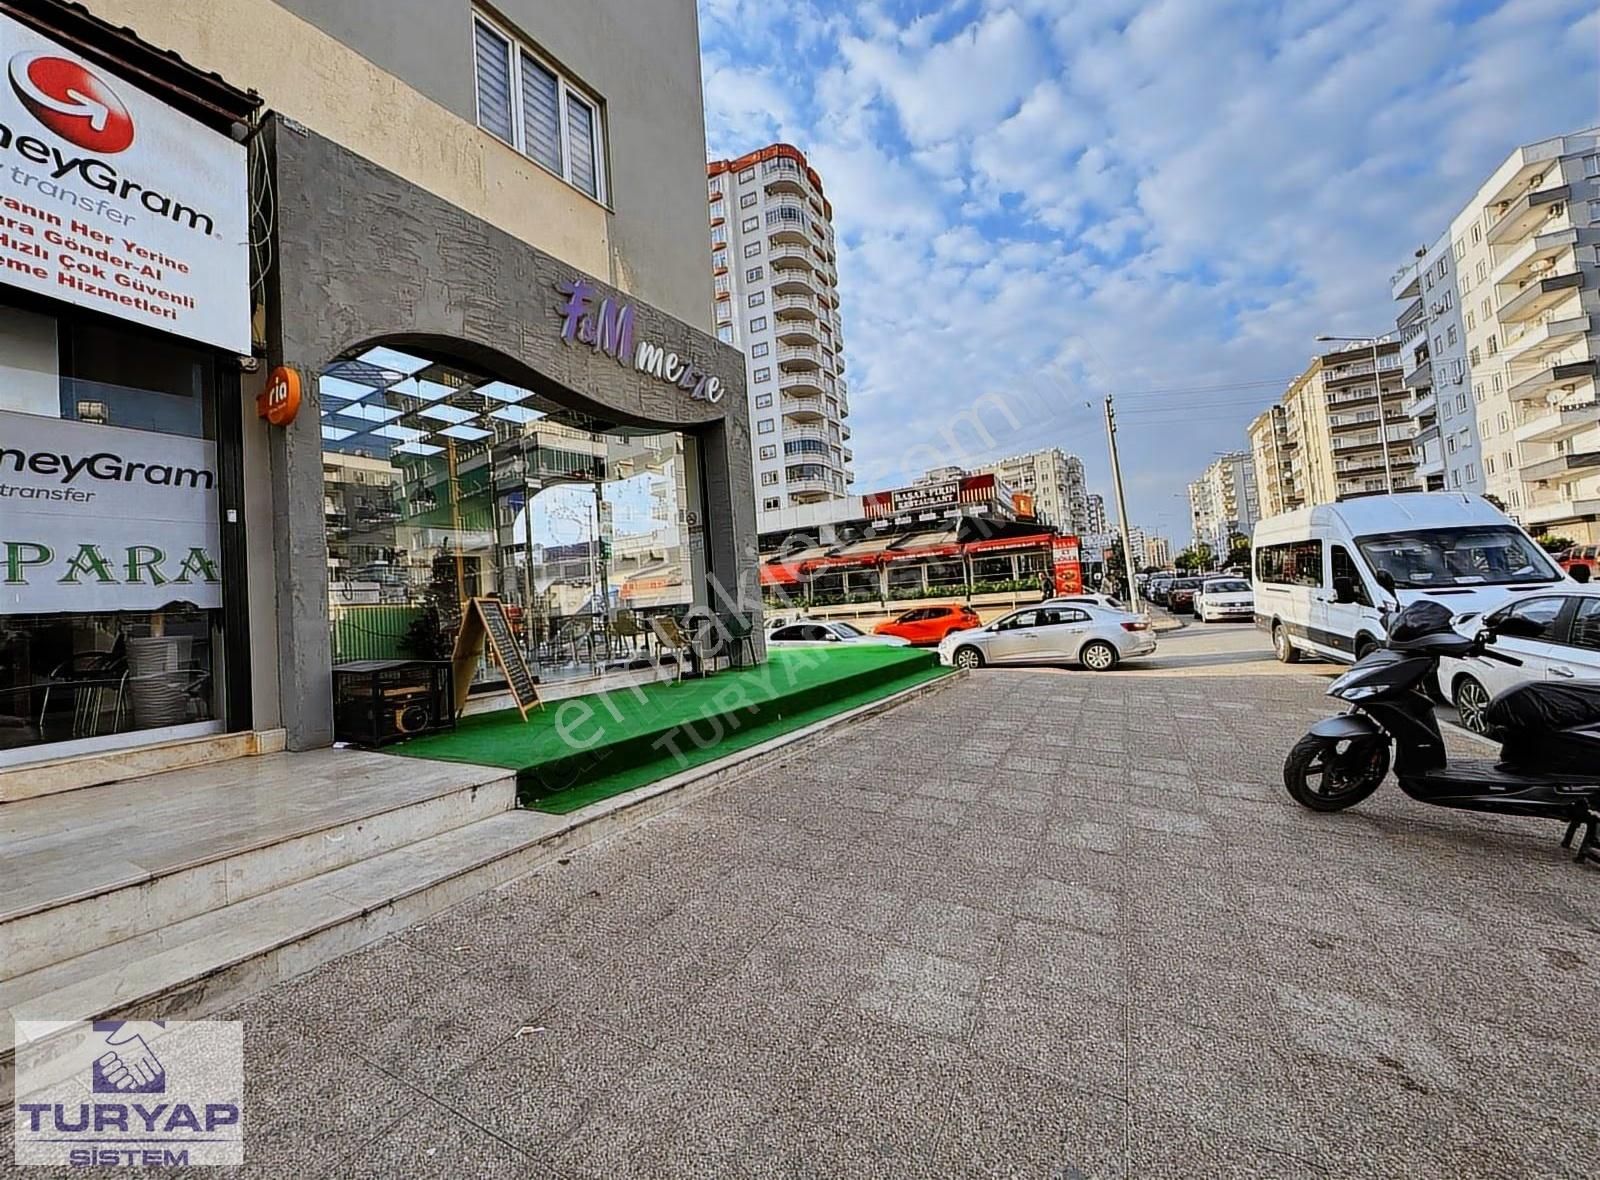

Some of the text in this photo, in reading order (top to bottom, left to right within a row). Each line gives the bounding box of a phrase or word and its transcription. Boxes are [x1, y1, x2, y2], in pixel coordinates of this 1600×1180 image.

[10, 166, 136, 226] transfer
[0, 195, 189, 274] anın Her Yerine
[44, 230, 161, 281] Gönder-Al
[58, 254, 106, 280] Çok
[114, 273, 195, 309] Güvenli
[58, 271, 177, 320] Hizmetleri
[269, 376, 287, 406] ria
[0, 483, 96, 503] transfer
[0, 541, 222, 587] PARA
